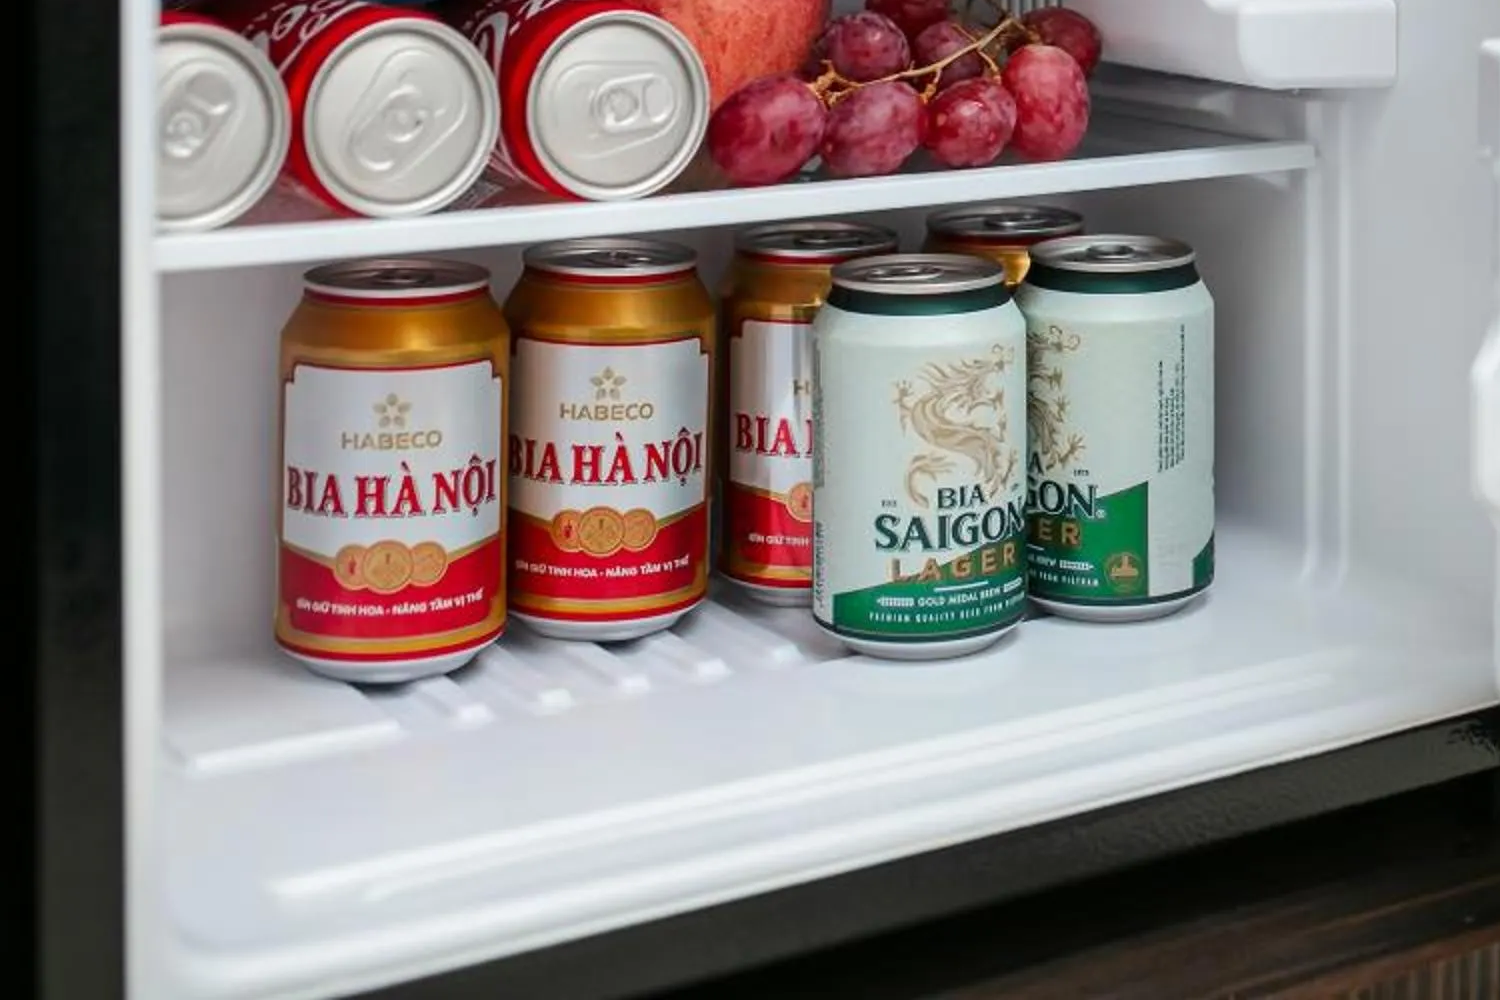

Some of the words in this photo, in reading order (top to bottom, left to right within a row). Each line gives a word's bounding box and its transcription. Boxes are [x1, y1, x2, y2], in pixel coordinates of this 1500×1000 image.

[560, 402, 654, 421] HABECO
[341, 430, 442, 450] HABECO
[736, 412, 799, 457] BIA
[509, 434, 564, 484] BIA
[570, 431, 638, 486] HÀ
[643, 426, 703, 486] NỘI
[287, 465, 348, 518] BIA
[354, 461, 426, 518] HÀ
[431, 453, 497, 518] NỘI
[937, 483, 988, 509] BIA
[874, 495, 1025, 551] SAIGON
[574, 566, 598, 578] HOA
[886, 542, 1016, 583] LAGER
[358, 604, 384, 616] HOA
[918, 596, 946, 607] GOLD
